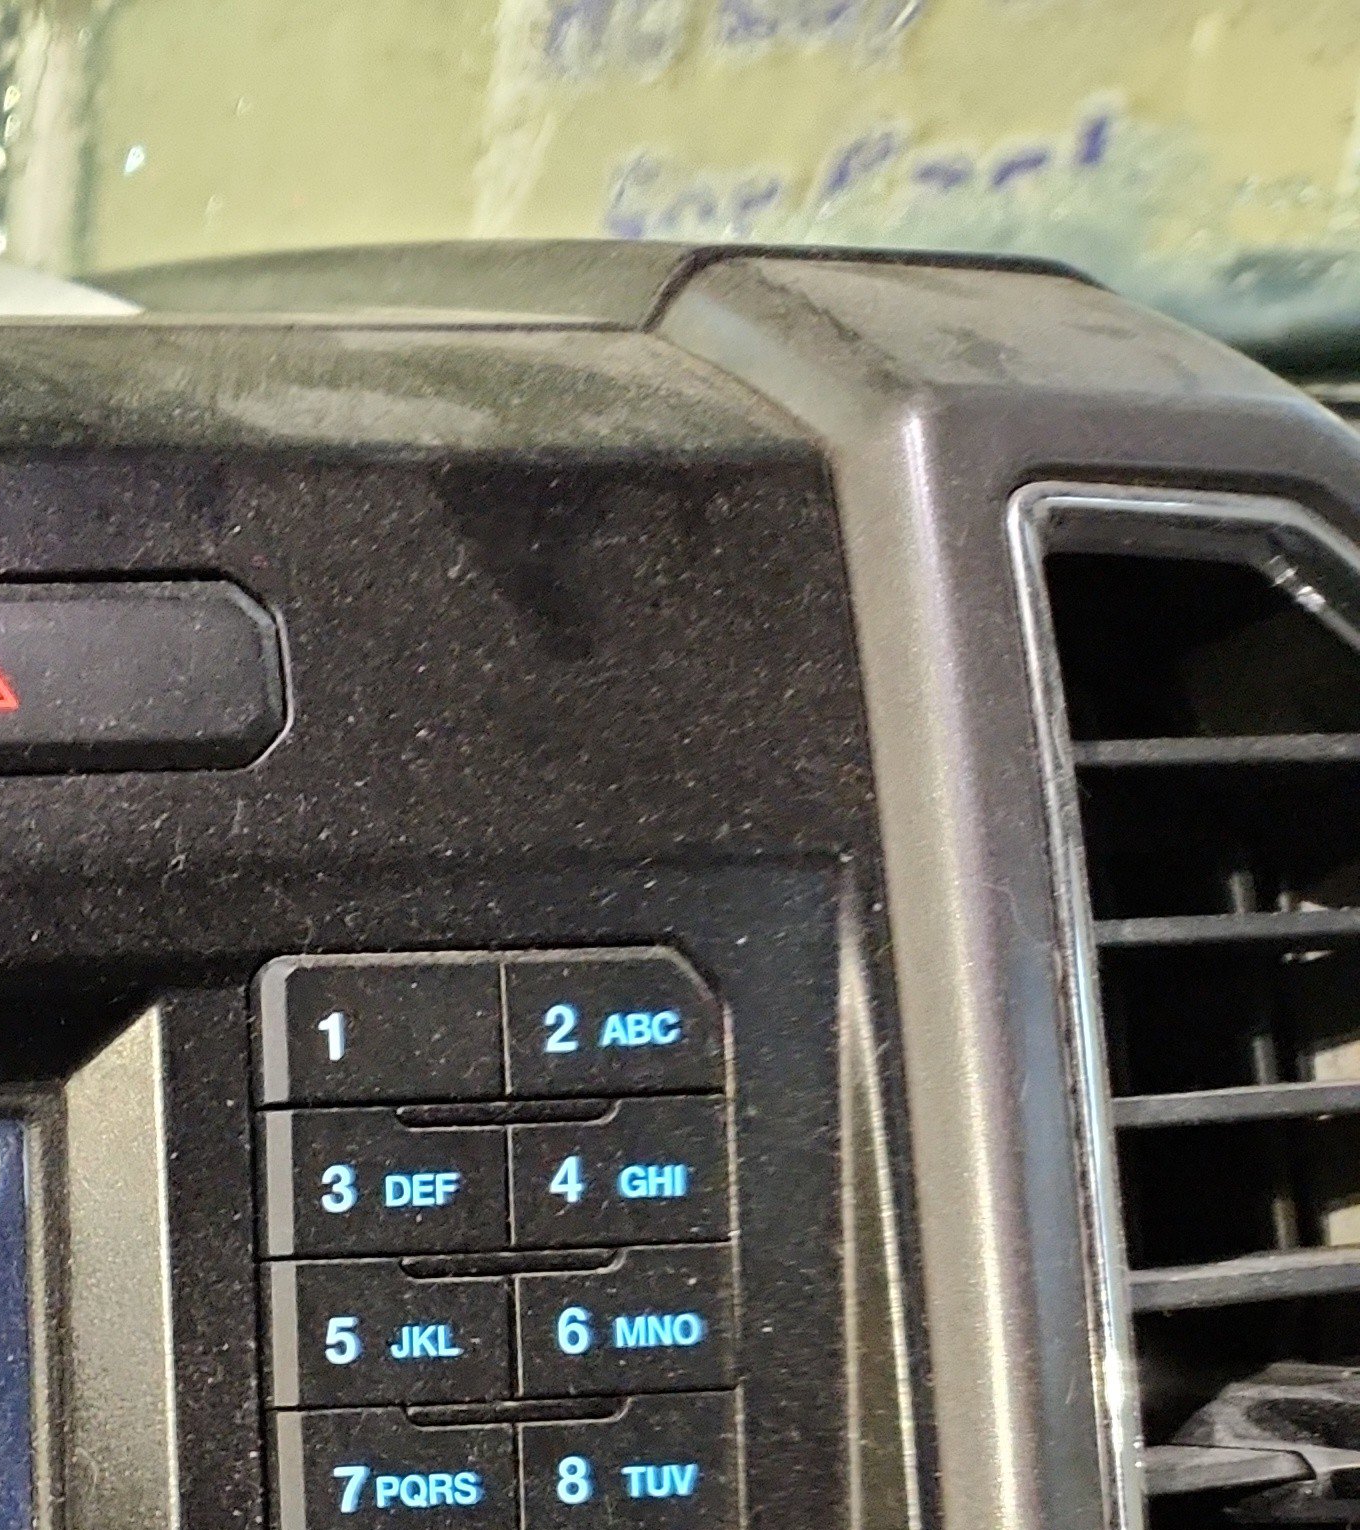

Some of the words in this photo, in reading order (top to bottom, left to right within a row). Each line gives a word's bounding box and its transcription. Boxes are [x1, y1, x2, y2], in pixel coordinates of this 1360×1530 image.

[316, 1011, 346, 1062] 1
[542, 1003, 580, 1054] 2
[598, 1009, 682, 1048] ABC
[320, 1163, 358, 1214] 3
[384, 1170, 462, 1208] DEF
[548, 1154, 586, 1204] 4
[615, 1162, 688, 1200] GHI
[323, 1315, 362, 1366] 5
[389, 1323, 465, 1360] JKL
[556, 1305, 594, 1356] 6
[611, 1311, 705, 1350] MNO
[332, 1464, 372, 1514] 7
[374, 1470, 485, 1510] PQRS
[555, 1455, 593, 1506] 8
[619, 1462, 699, 1499] TUV
